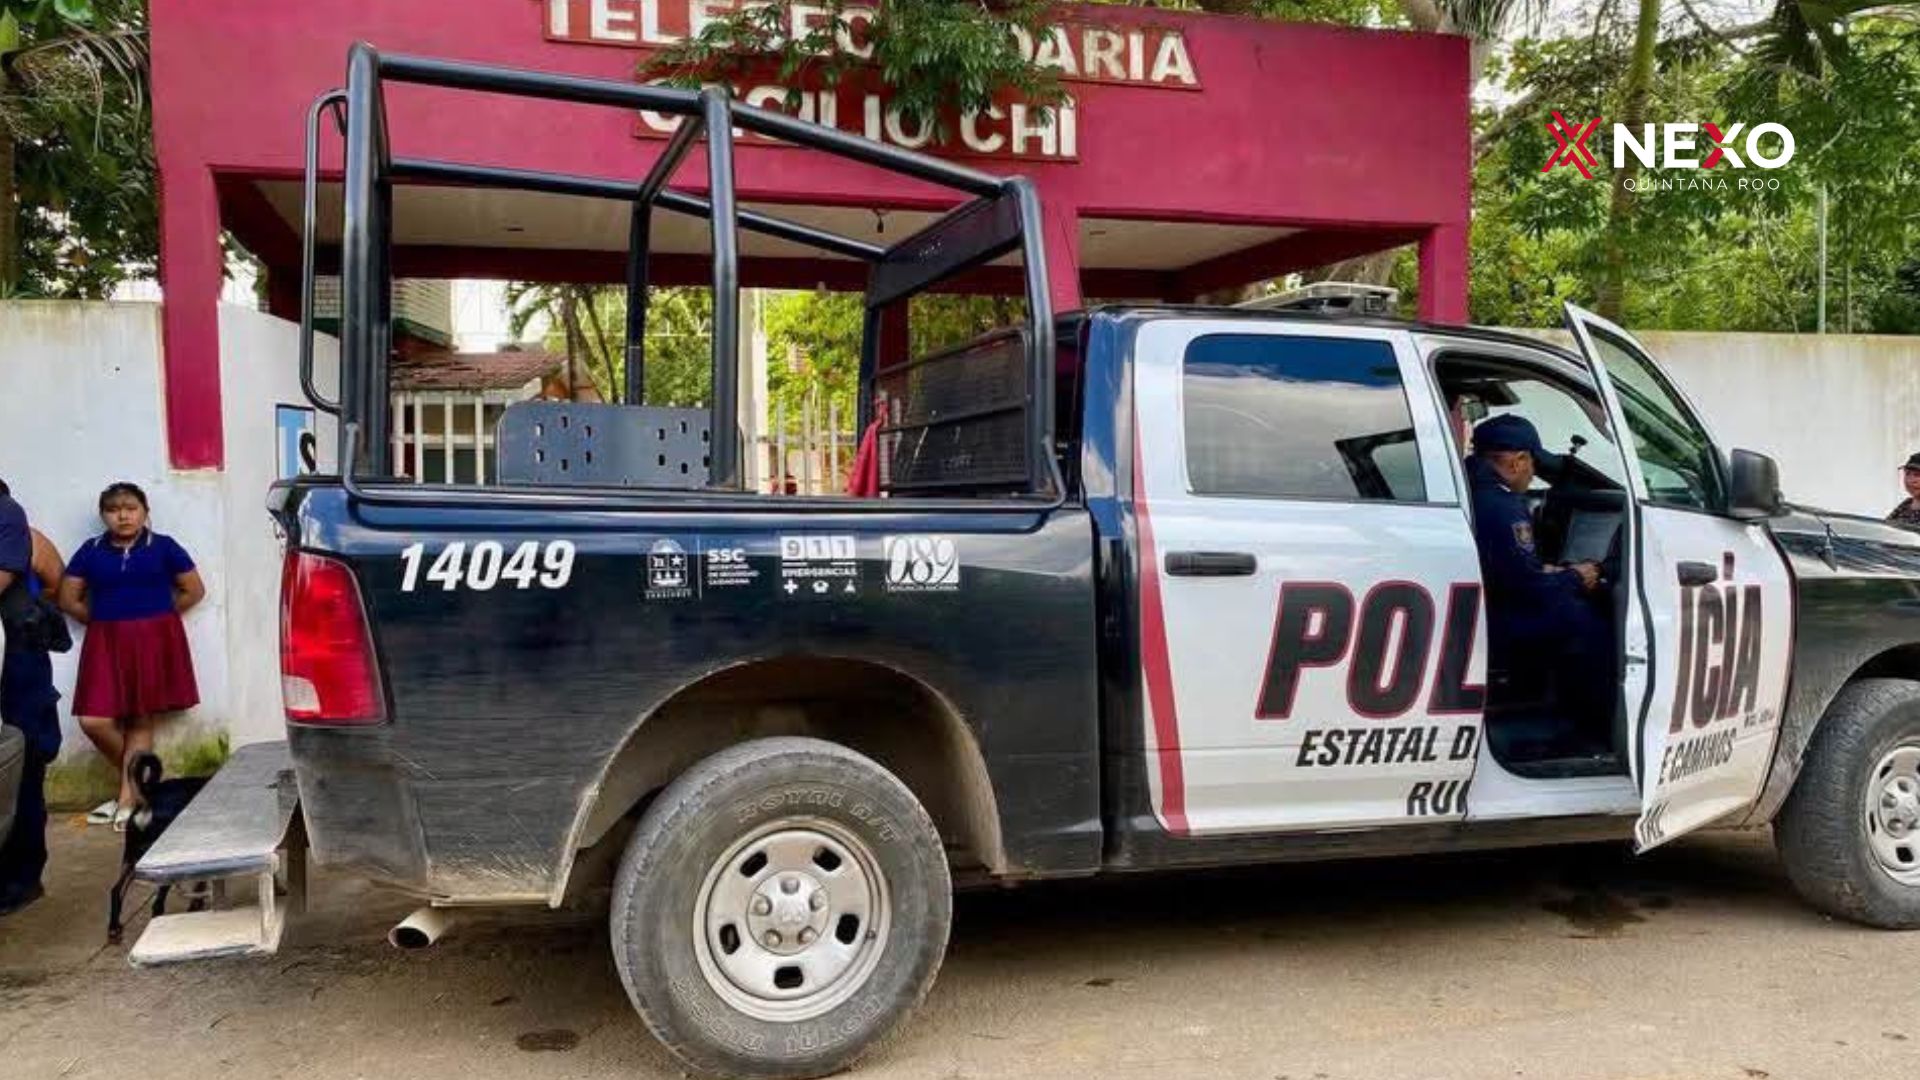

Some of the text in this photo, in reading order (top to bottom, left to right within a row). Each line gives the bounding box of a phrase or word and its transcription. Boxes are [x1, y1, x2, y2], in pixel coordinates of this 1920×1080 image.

[550, 0, 1198, 85] TELEECARIA
[401, 540, 576, 592] 14049
[707, 548, 746, 563] SSC
[784, 537, 855, 558] 911
[1255, 579, 1486, 720] POL
[1296, 725, 1480, 767] ESTATAL D
